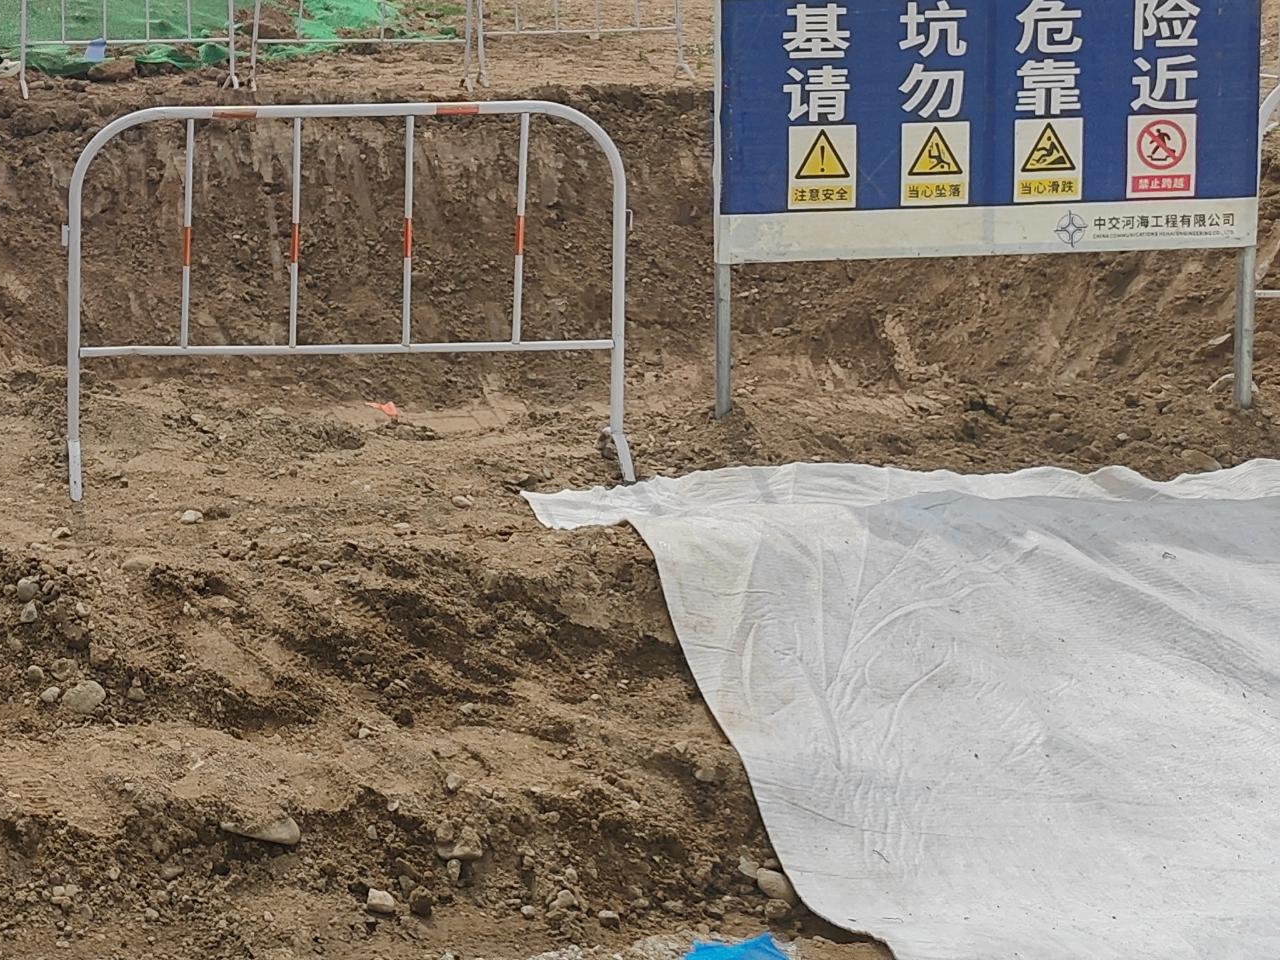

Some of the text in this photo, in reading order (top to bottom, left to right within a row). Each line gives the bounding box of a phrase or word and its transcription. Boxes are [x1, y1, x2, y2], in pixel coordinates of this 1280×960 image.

[782, 53, 1199, 123] 请勿靠近
[1020, 180, 1074, 195] 当心滑跌
[1138, 177, 1185, 190] 禁止跨越
[794, 187, 849, 202] 注意安全
[908, 184, 962, 199] 当心坠落
[1093, 212, 1235, 231] 中交河海工程有限公司
